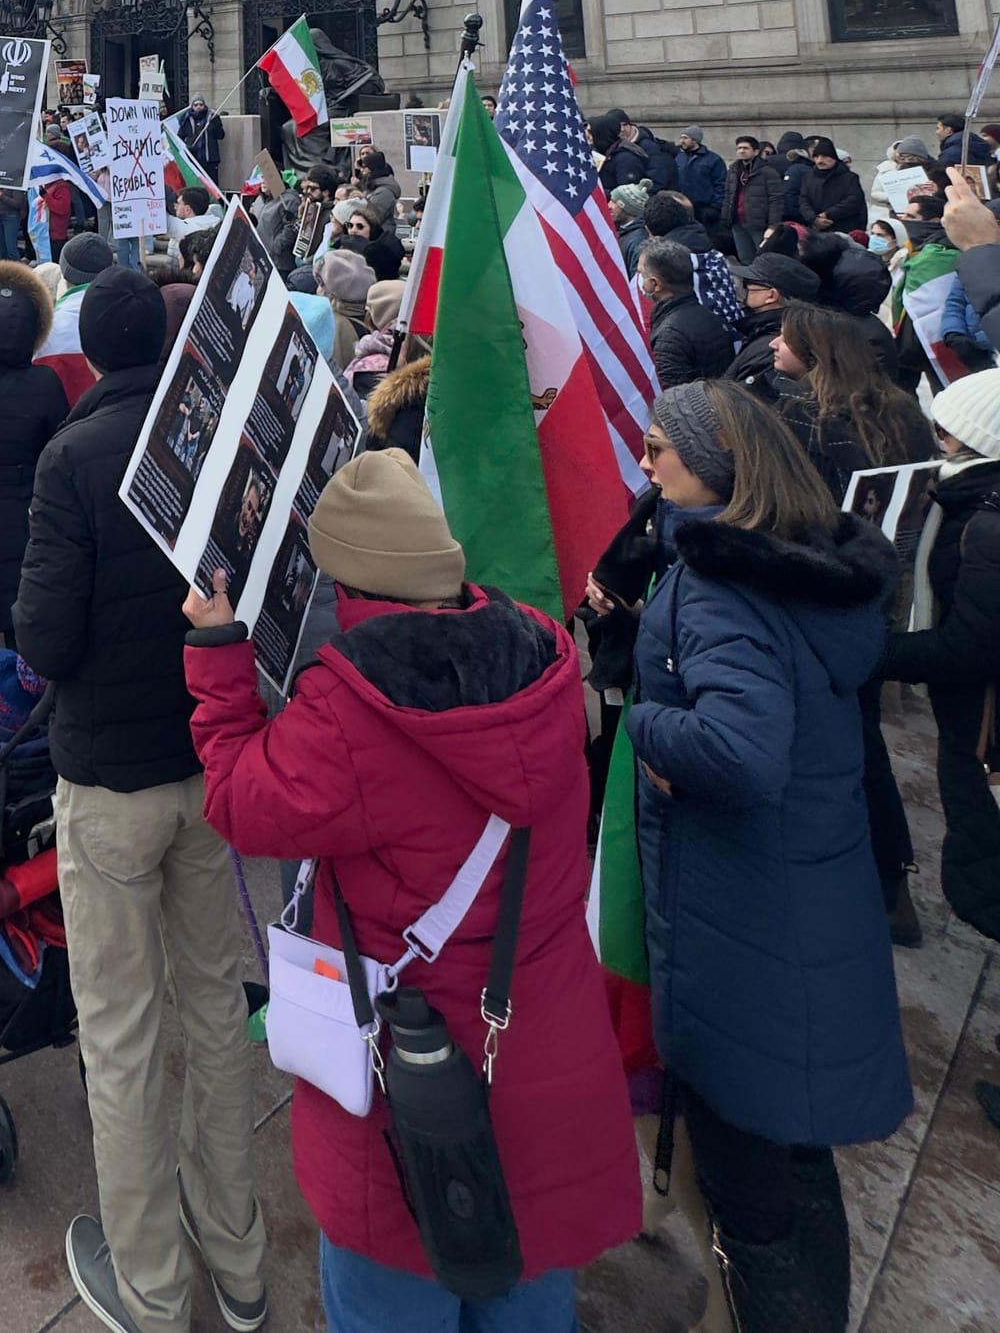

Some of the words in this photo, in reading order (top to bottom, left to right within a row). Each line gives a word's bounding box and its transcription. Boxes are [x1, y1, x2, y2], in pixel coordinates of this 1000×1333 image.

[109, 105, 138, 123] DOWN
[141, 105, 160, 121] WITH
[128, 125, 139, 134] THE
[112, 137, 162, 161] ISLAMIC
[112, 171, 157, 197] REPUBLIC
